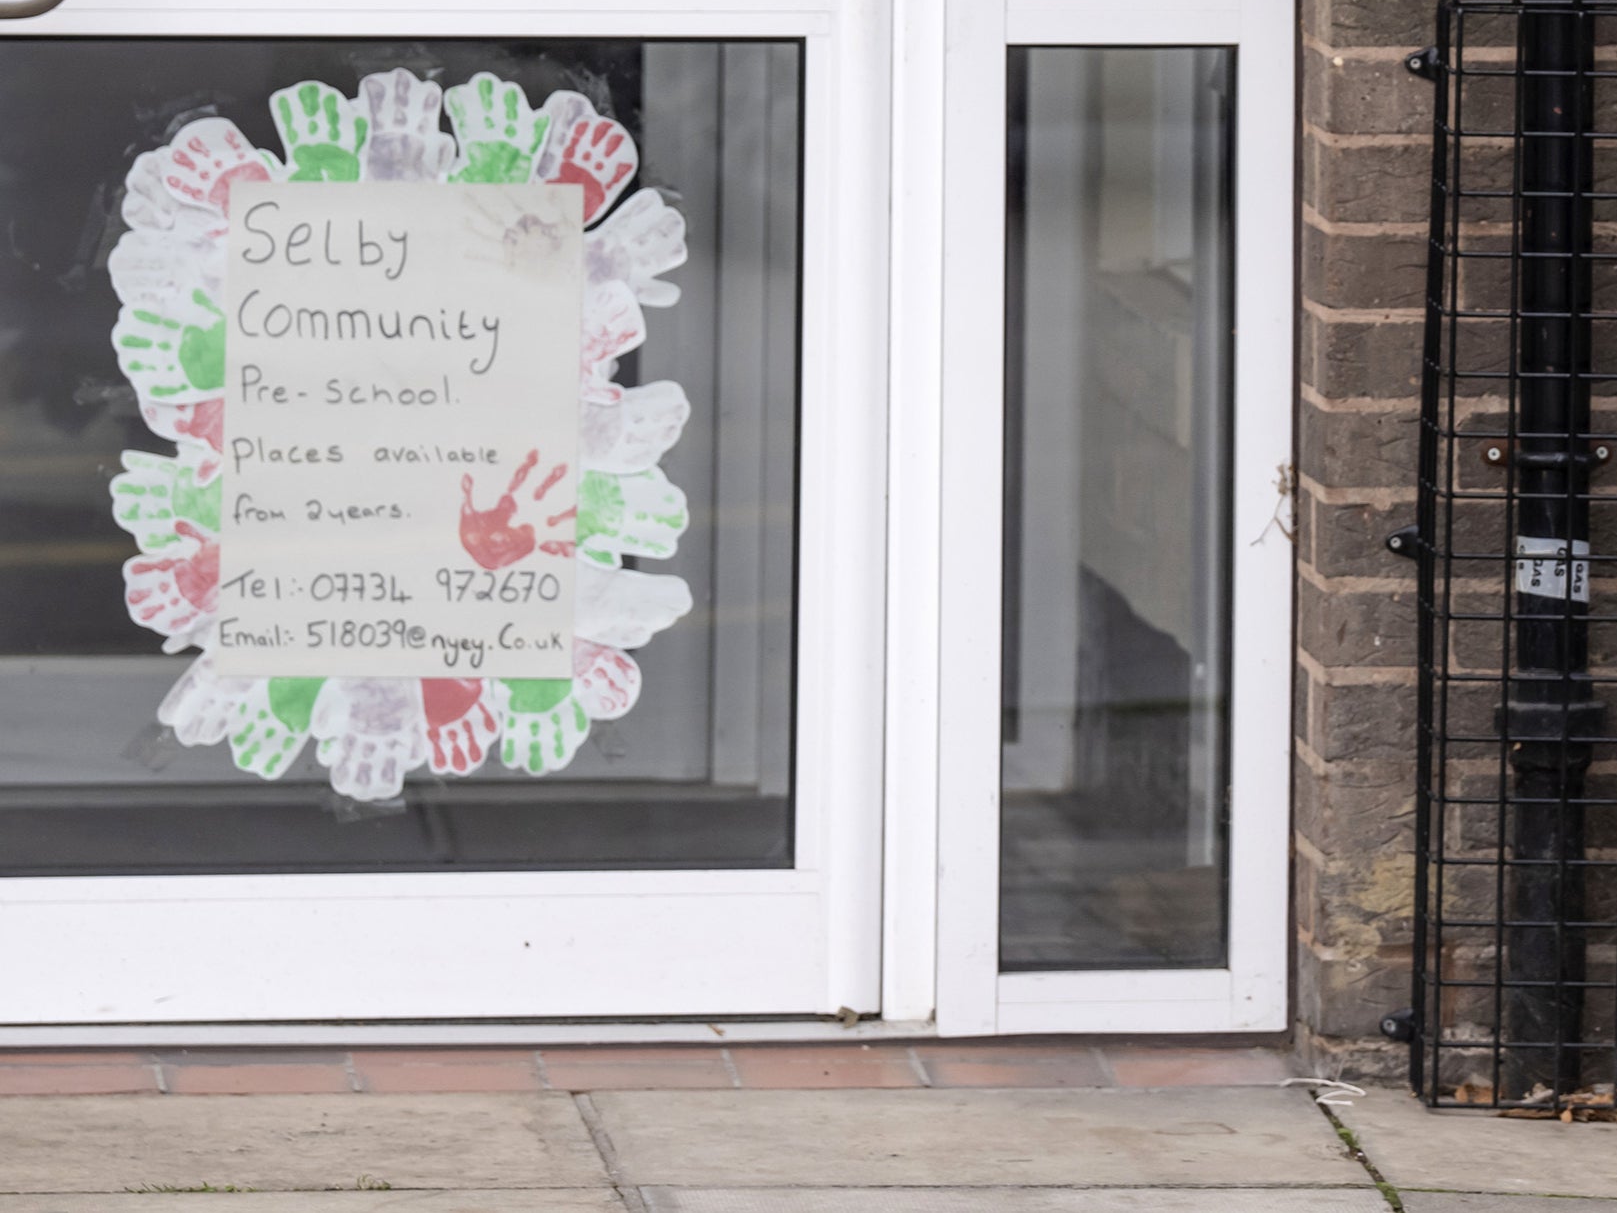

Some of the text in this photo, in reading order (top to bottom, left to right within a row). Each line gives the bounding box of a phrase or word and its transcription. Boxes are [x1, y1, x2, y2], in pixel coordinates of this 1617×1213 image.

[242, 201, 407, 280] Selby
[238, 289, 500, 374] Community
[232, 437, 499, 474] Places available
[233, 493, 286, 525] from
[310, 573, 412, 604] 07734
[436, 568, 560, 603] 972670
